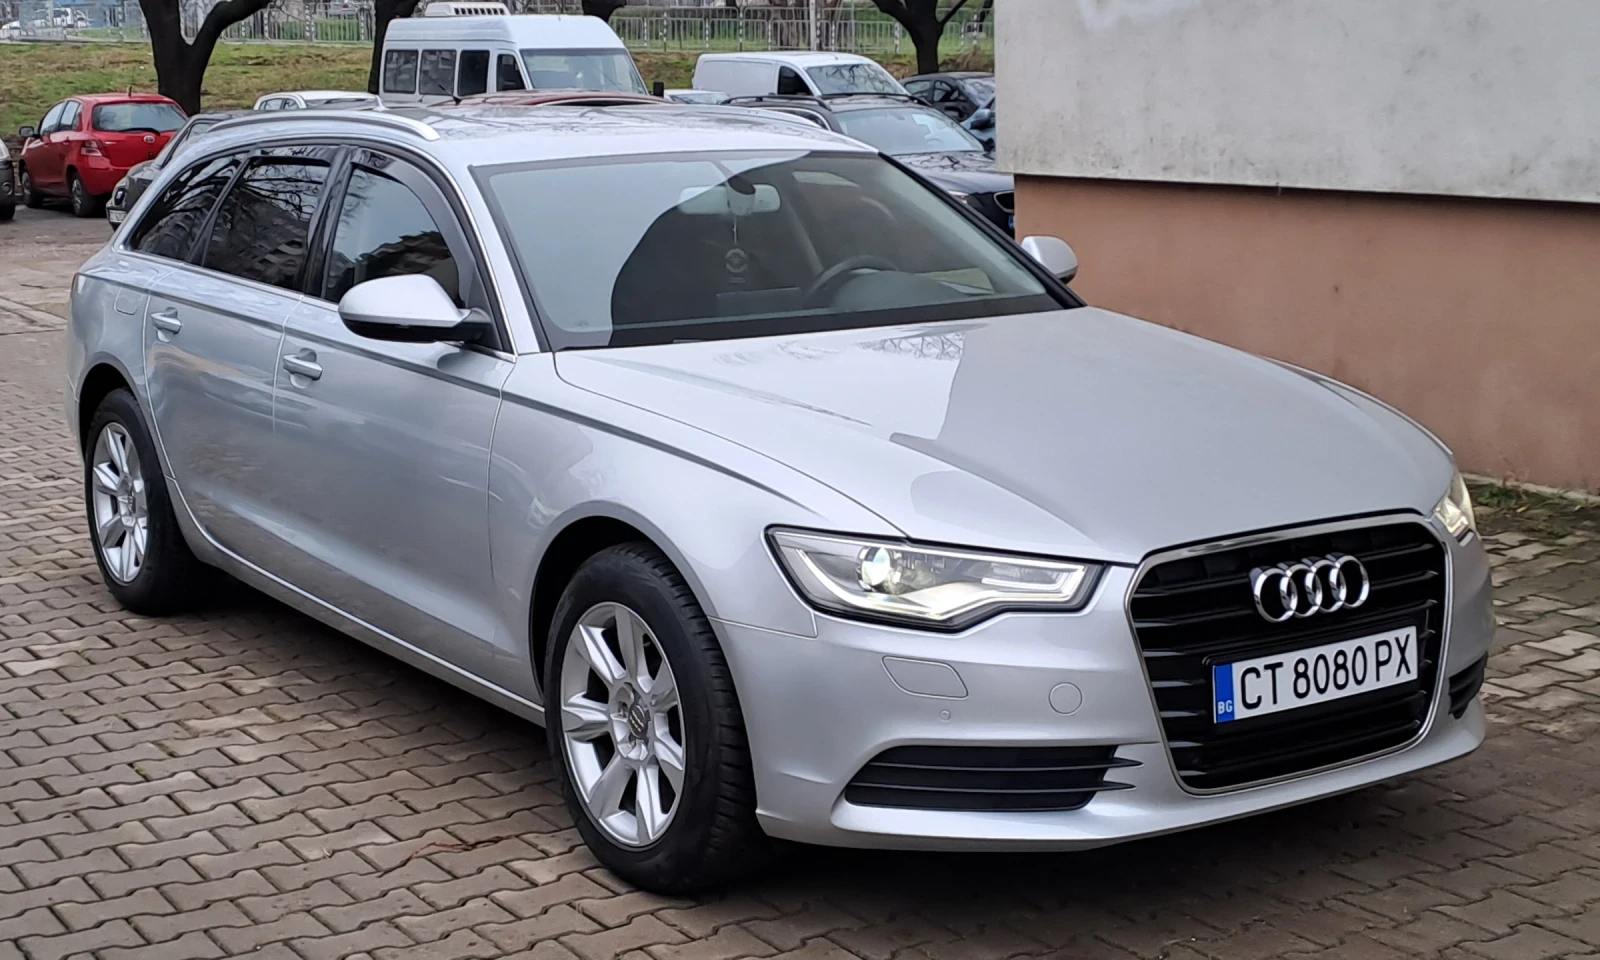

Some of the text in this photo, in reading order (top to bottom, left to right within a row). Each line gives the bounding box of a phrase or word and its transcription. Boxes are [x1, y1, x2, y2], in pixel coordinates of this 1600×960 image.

[1241, 634, 1411, 710] CT 8080 PX
[1217, 700, 1233, 715] BG
